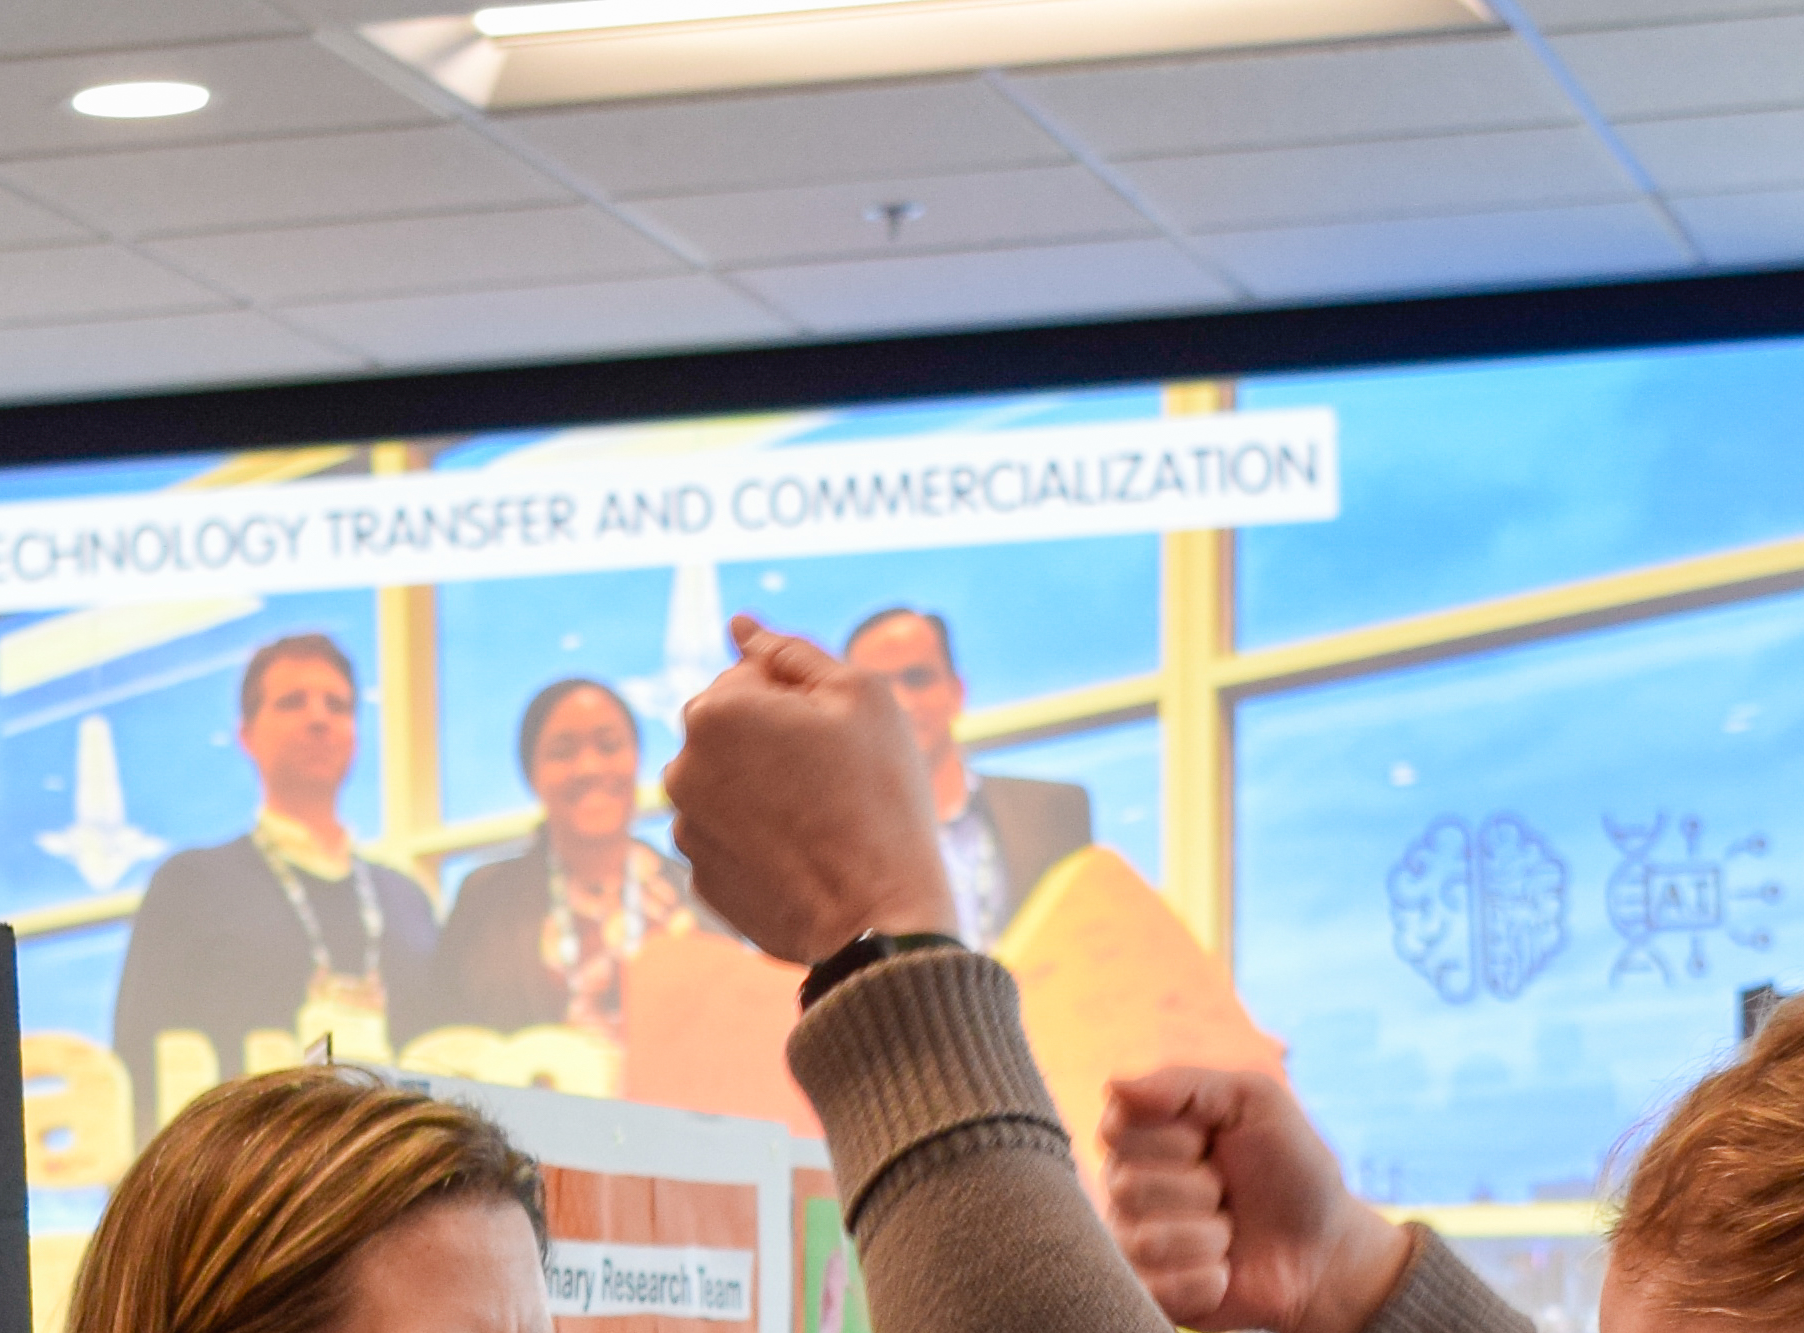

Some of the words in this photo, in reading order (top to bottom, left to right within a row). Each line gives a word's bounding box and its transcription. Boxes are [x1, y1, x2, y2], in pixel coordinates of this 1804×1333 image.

[326, 492, 581, 556] TRANSFER
[598, 487, 712, 540] AND
[731, 440, 1321, 534] COMMERCIALIZATION
[1659, 883, 1711, 914] AI
[601, 1257, 691, 1305] Research
[697, 1264, 743, 1310] Team
